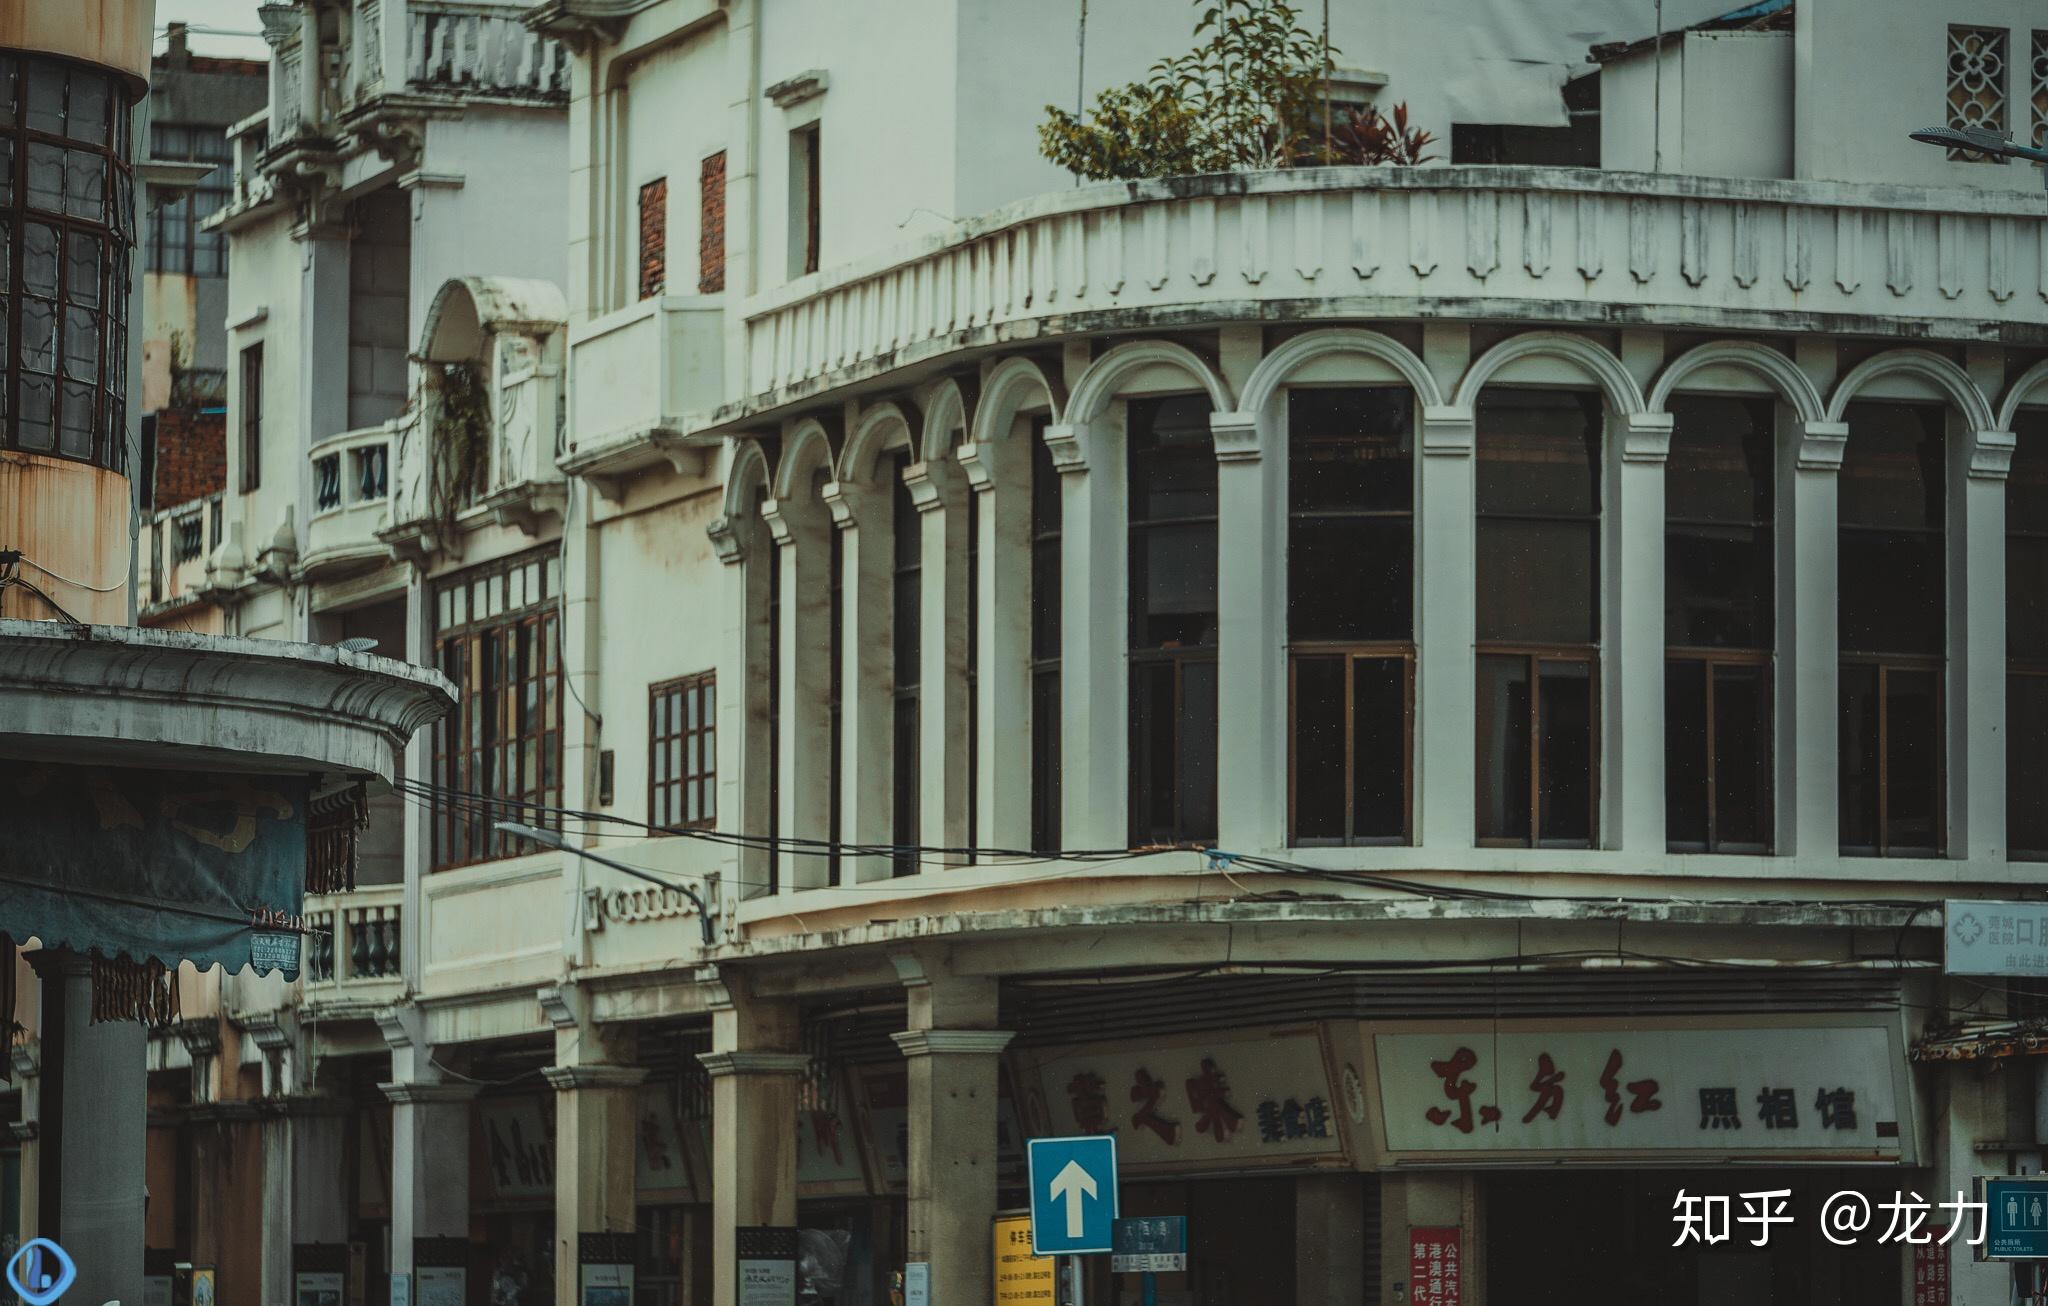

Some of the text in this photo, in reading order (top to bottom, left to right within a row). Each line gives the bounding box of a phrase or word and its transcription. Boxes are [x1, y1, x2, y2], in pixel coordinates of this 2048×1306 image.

[1989, 932, 2015, 945] 医院
[2006, 954, 2048, 969] 由此进
[1426, 1046, 1858, 1134] 东方红 照相馆
[1413, 1243, 1427, 1302] 第二代
